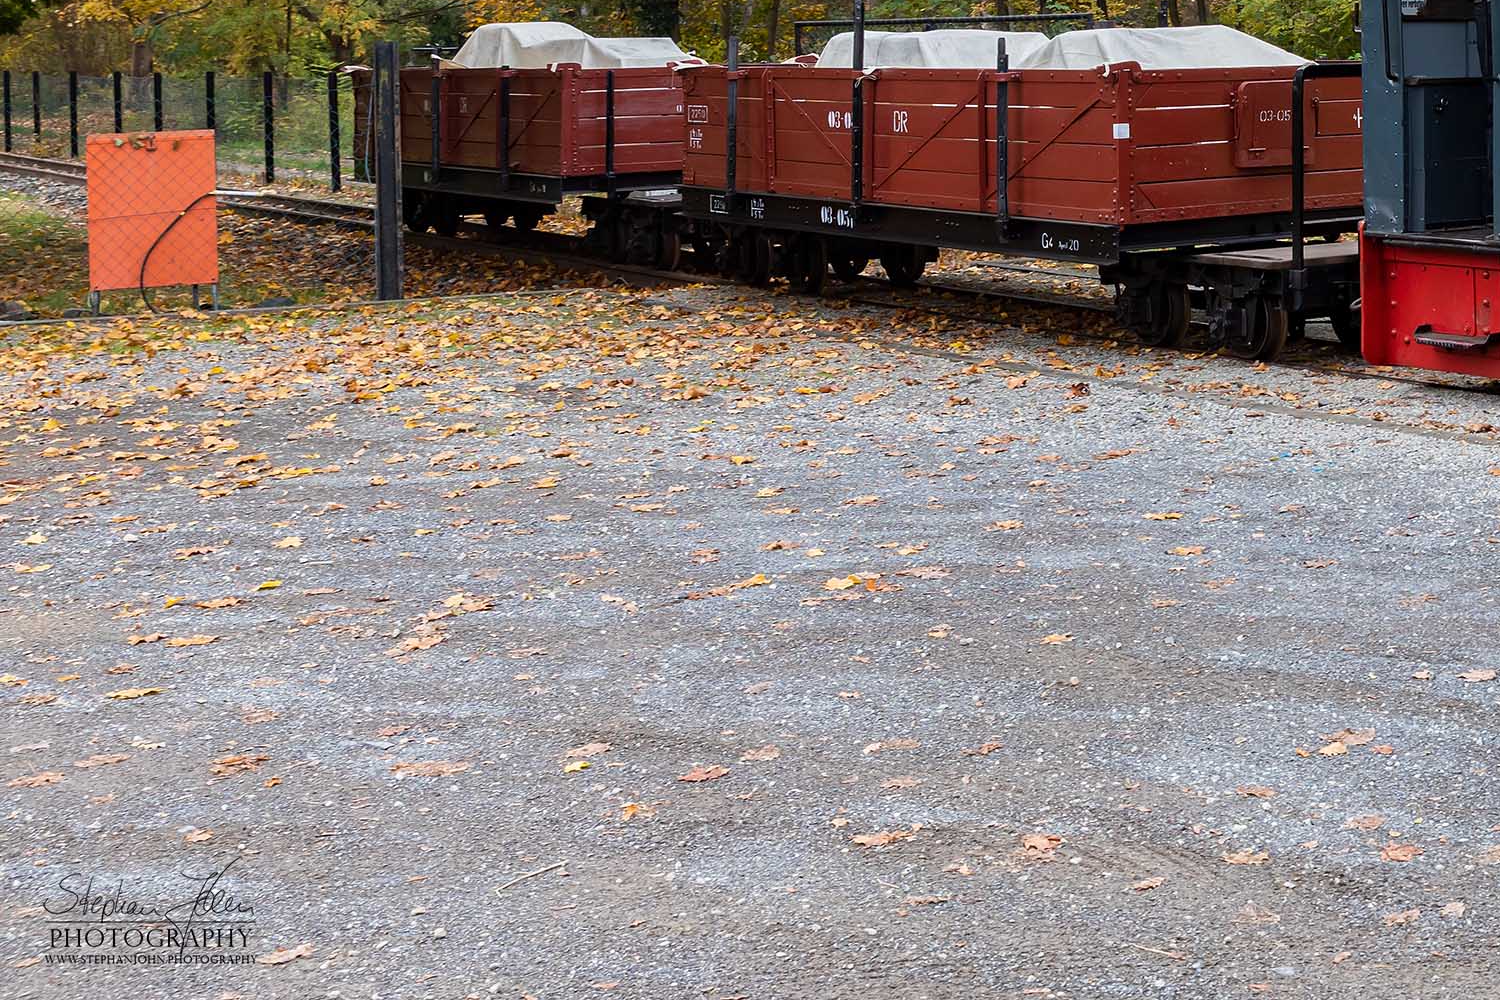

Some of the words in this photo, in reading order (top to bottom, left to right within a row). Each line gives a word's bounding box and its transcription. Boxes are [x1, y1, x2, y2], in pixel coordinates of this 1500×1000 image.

[828, 111, 853, 129] 03-0
[893, 110, 908, 133] DR
[1260, 110, 1292, 122] 03-05
